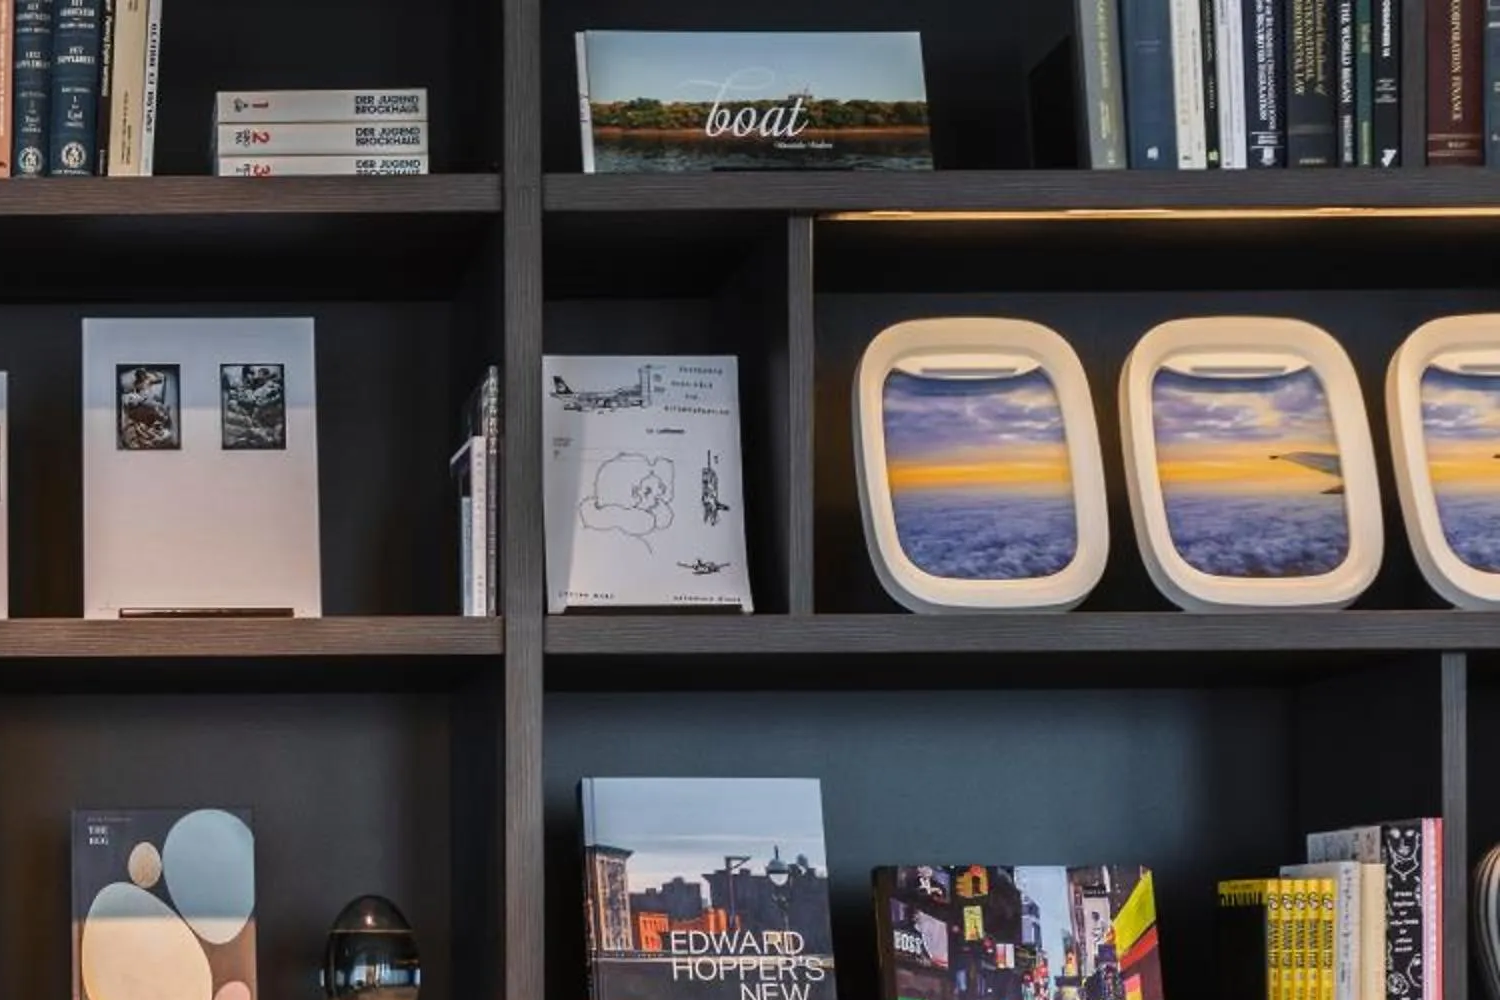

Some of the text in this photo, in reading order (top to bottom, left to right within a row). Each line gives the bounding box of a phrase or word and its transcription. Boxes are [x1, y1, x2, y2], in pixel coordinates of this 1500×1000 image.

[695, 69, 809, 137] boat
[670, 930, 805, 955] EDWARD
[671, 955, 826, 981] HOPPER'S
